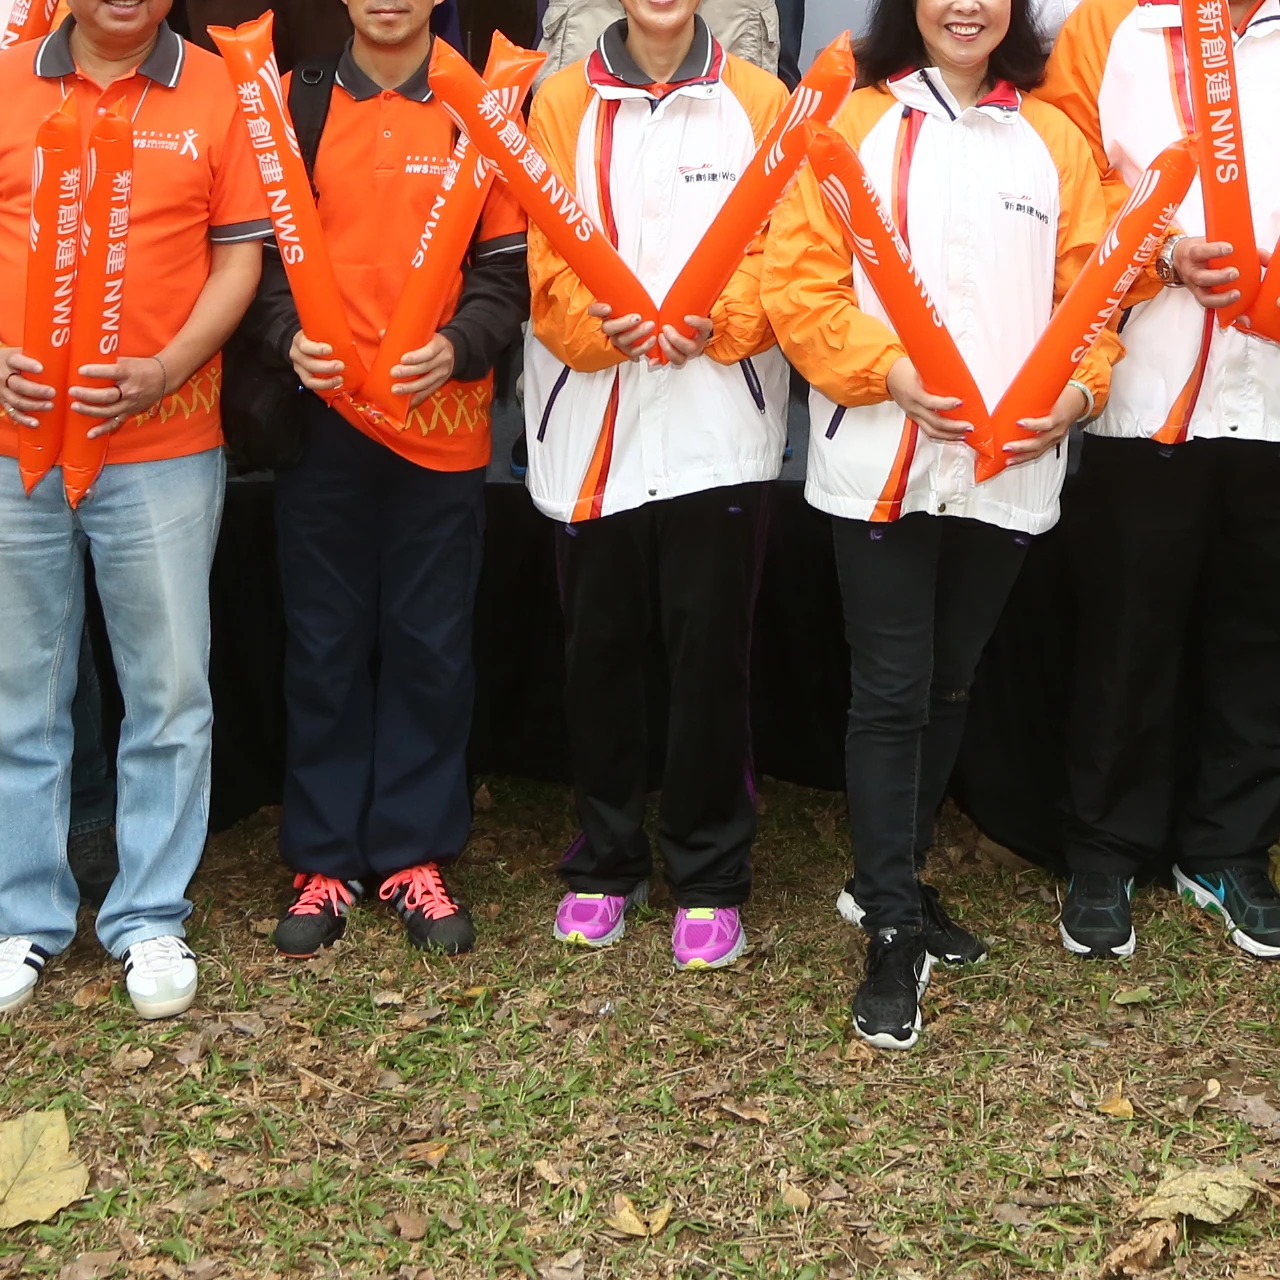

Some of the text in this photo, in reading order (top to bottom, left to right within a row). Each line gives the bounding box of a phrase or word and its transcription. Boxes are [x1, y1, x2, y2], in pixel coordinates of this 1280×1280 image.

[237, 80, 305, 266] 新創建 NWS
[404, 163, 429, 175] NWS
[477, 87, 596, 243] 新創建 NWS
[1196, 0, 1239, 185] 新創建 NWS
[50, 166, 82, 349] 新創建 NWS
[99, 168, 132, 355] 新創建 NWS
[1035, 209, 1050, 225] NWS
[1069, 293, 1120, 364] NWS
